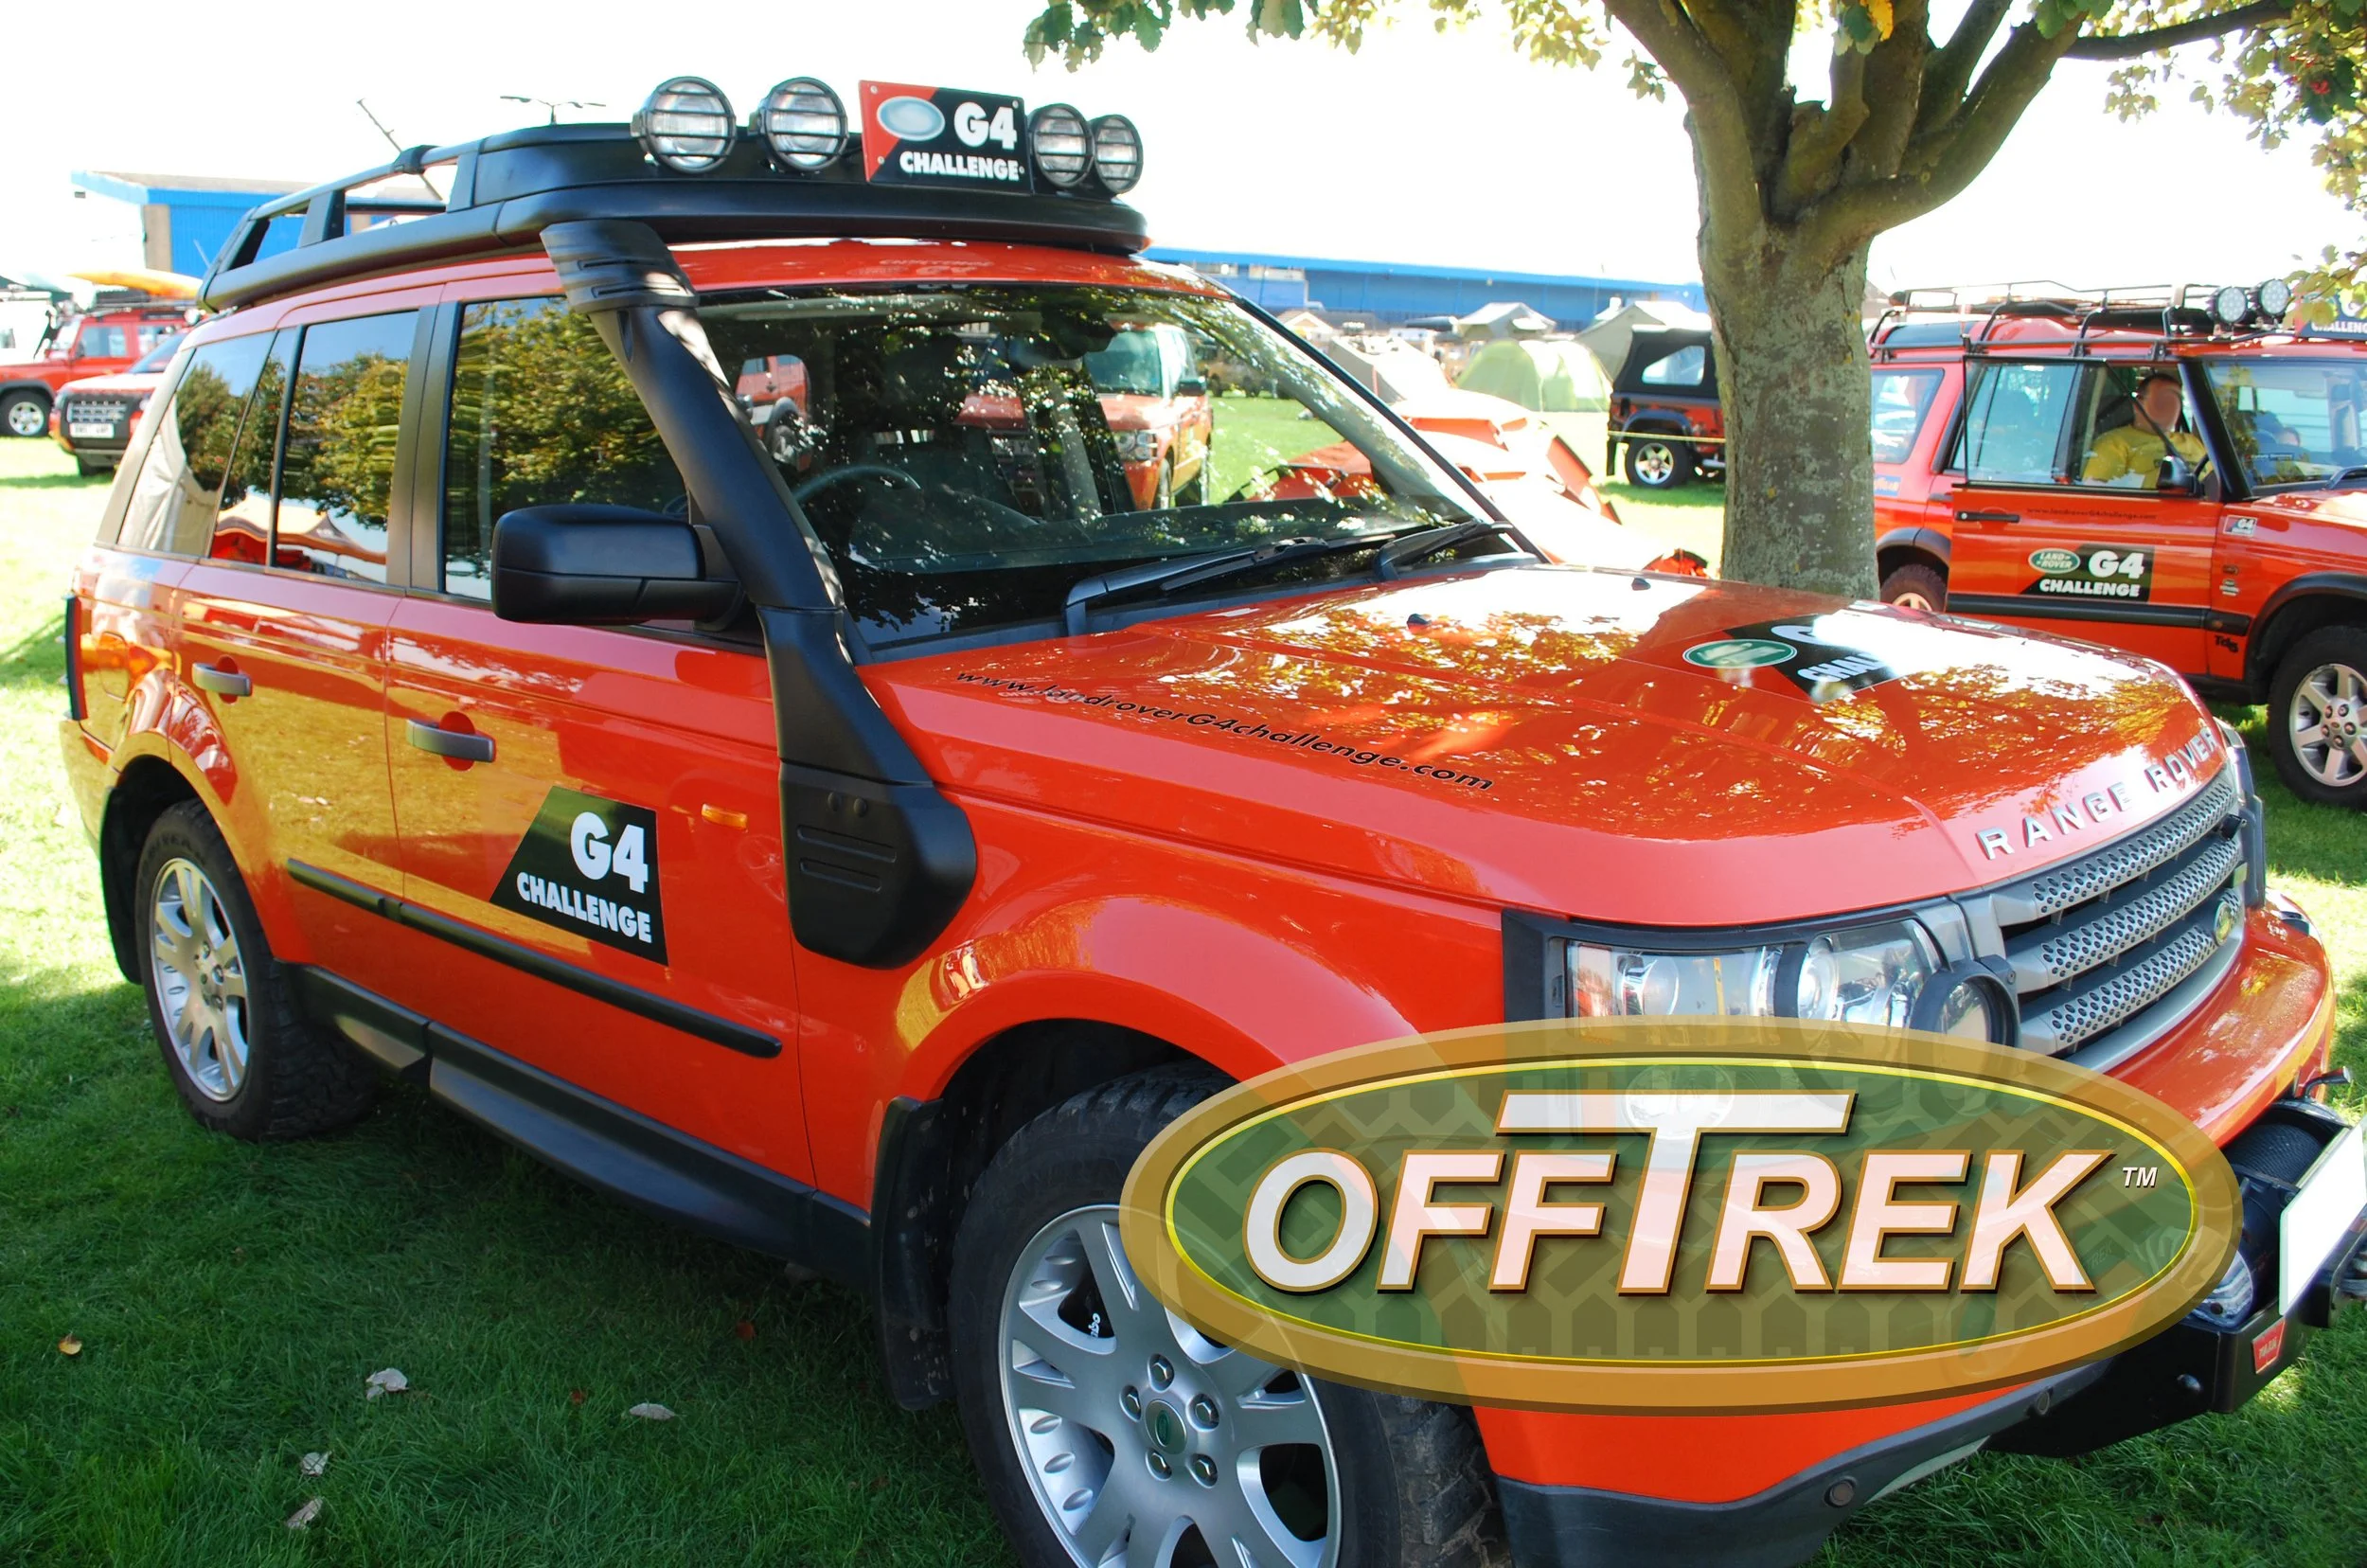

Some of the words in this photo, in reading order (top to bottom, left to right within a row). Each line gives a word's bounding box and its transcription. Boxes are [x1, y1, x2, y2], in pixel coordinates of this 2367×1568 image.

[953, 101, 1017, 151] G4
[899, 151, 1020, 182] CHALLENGE
[2039, 579, 2141, 597] CHALLENGE
[2089, 550, 2145, 579] G4
[956, 671, 1493, 791] www.landroverG4challenge.com
[1976, 781, 2133, 861] RANGE
[2144, 727, 2219, 793] ROVER
[571, 811, 649, 894] G4
[517, 871, 652, 944] CHALLENGE
